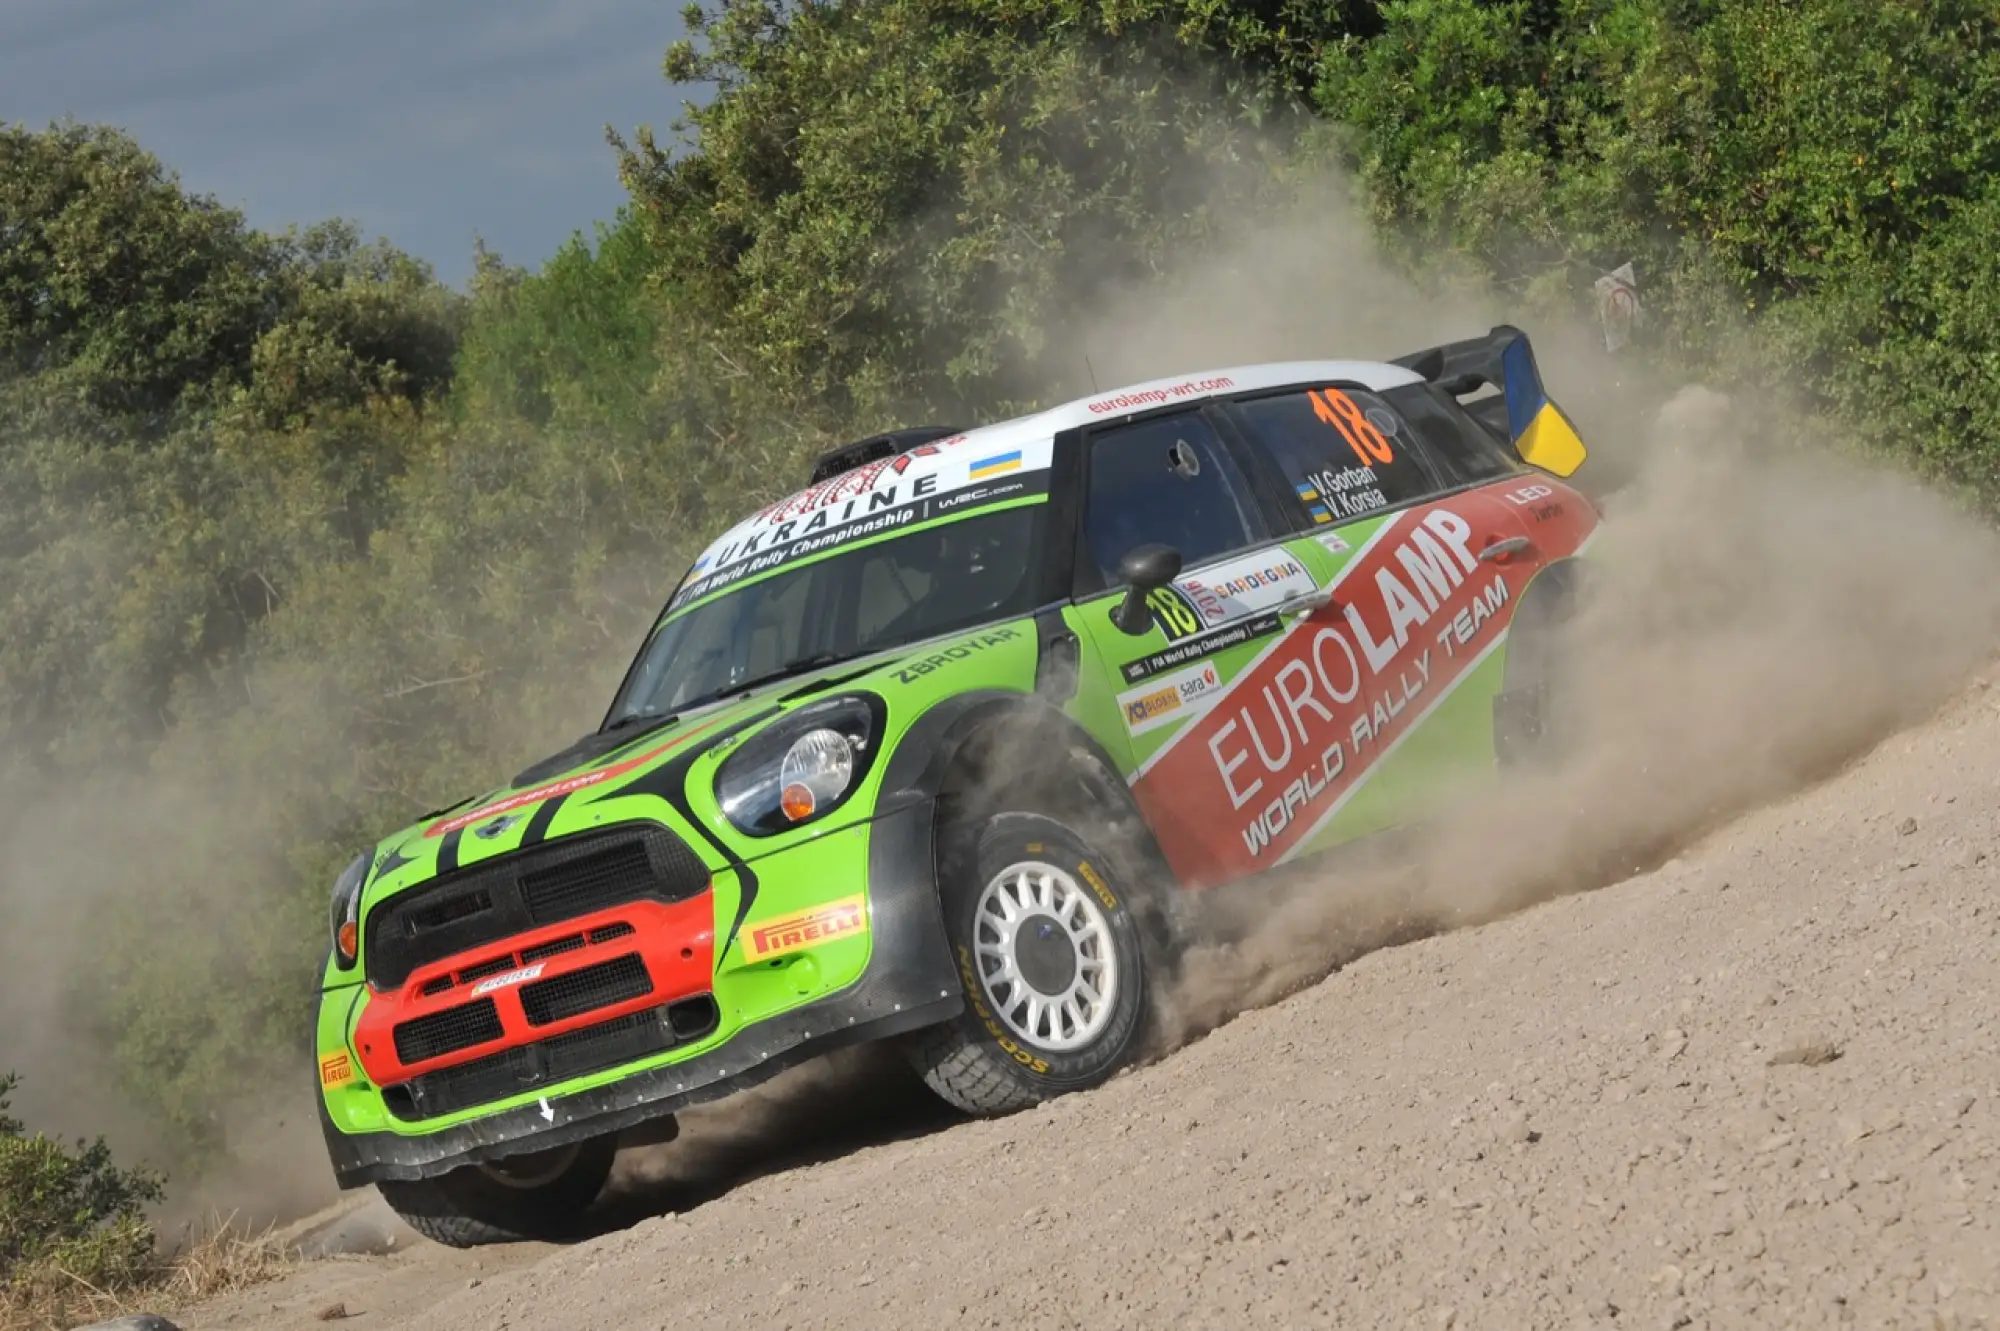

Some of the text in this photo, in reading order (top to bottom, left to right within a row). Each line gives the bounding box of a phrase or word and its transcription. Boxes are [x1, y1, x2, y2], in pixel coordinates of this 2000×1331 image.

[1088, 377, 1235, 414] eurolamp-wrt.com
[1306, 387, 1393, 468] 18
[714, 472, 938, 568] UKRAINE
[1504, 485, 1553, 506] LED
[709, 564, 748, 588] World
[748, 549, 788, 572] Rally
[790, 508, 915, 556] Championship
[1214, 561, 1300, 598] SARDEGNA
[1145, 586, 1197, 638] 18
[889, 628, 1021, 685] ZBROYAR
[1164, 649, 1185, 664] World
[1201, 629, 1246, 652] Championship
[1208, 508, 1478, 810] EUROLAMP
[1180, 677, 1205, 698] sara
[1241, 575, 1511, 857] WORLD RALLY TEAM
[752, 903, 861, 954] PIRELLI
